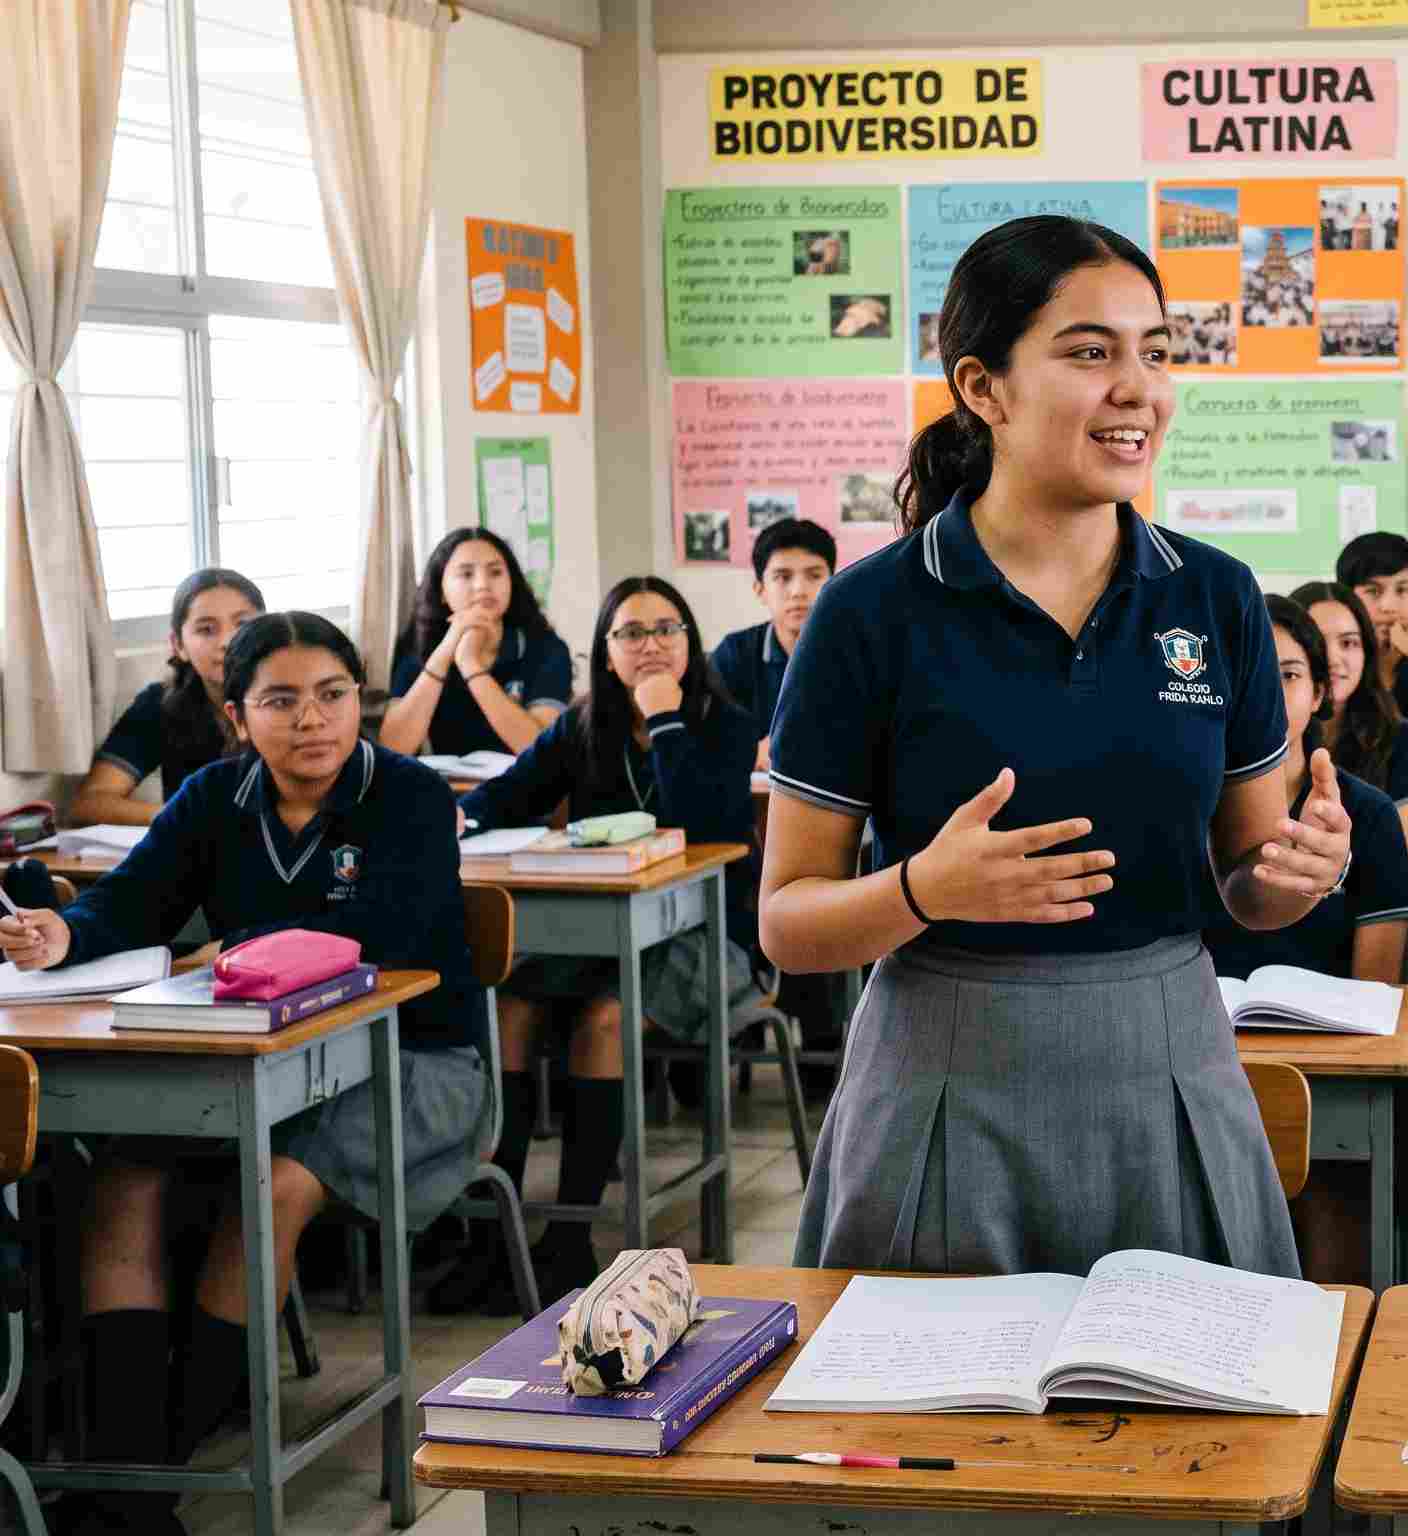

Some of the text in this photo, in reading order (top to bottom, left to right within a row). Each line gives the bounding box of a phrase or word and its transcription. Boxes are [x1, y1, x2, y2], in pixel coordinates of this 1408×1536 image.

[723, 67, 1028, 109] PROYECTO DE
[1162, 66, 1375, 105] CULTURA
[714, 114, 1038, 156] BIODIVERSIDAD
[1188, 114, 1352, 153] LATINA
[1158, 691, 1188, 703] FRIDA
